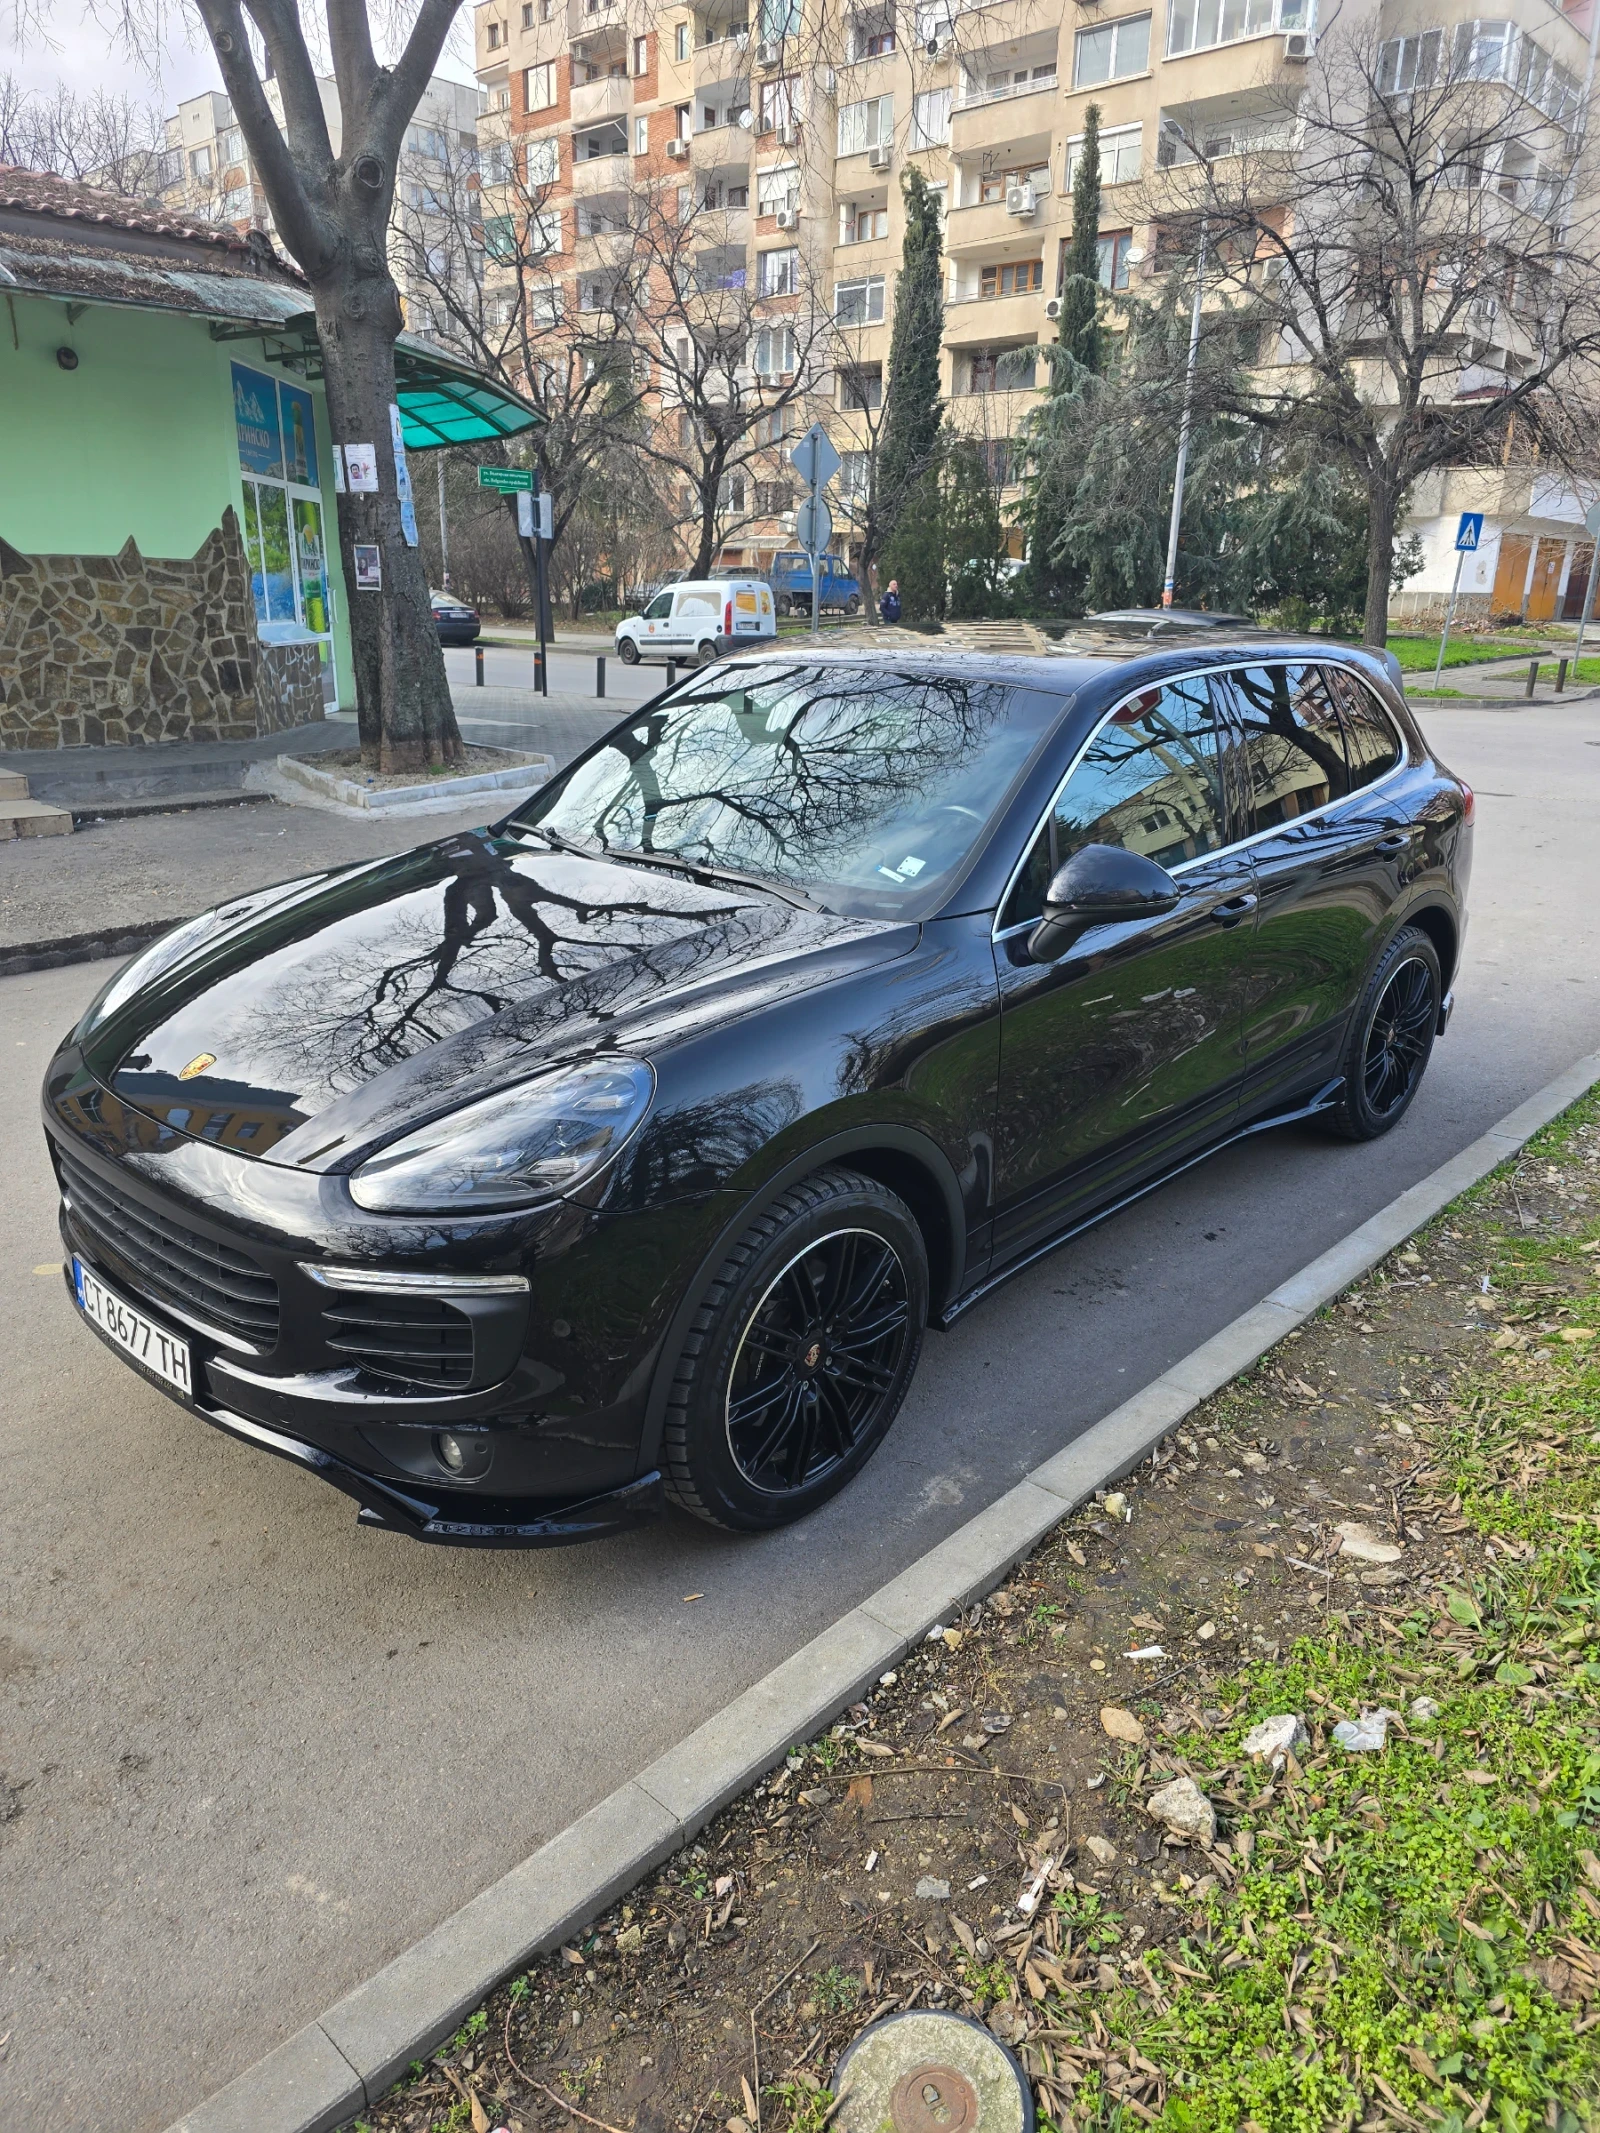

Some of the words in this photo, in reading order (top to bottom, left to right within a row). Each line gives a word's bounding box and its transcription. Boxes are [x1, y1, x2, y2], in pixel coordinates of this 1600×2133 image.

[84, 1274, 102, 1320] CT
[106, 1296, 151, 1357] 8677
[156, 1331, 188, 1386] TH
